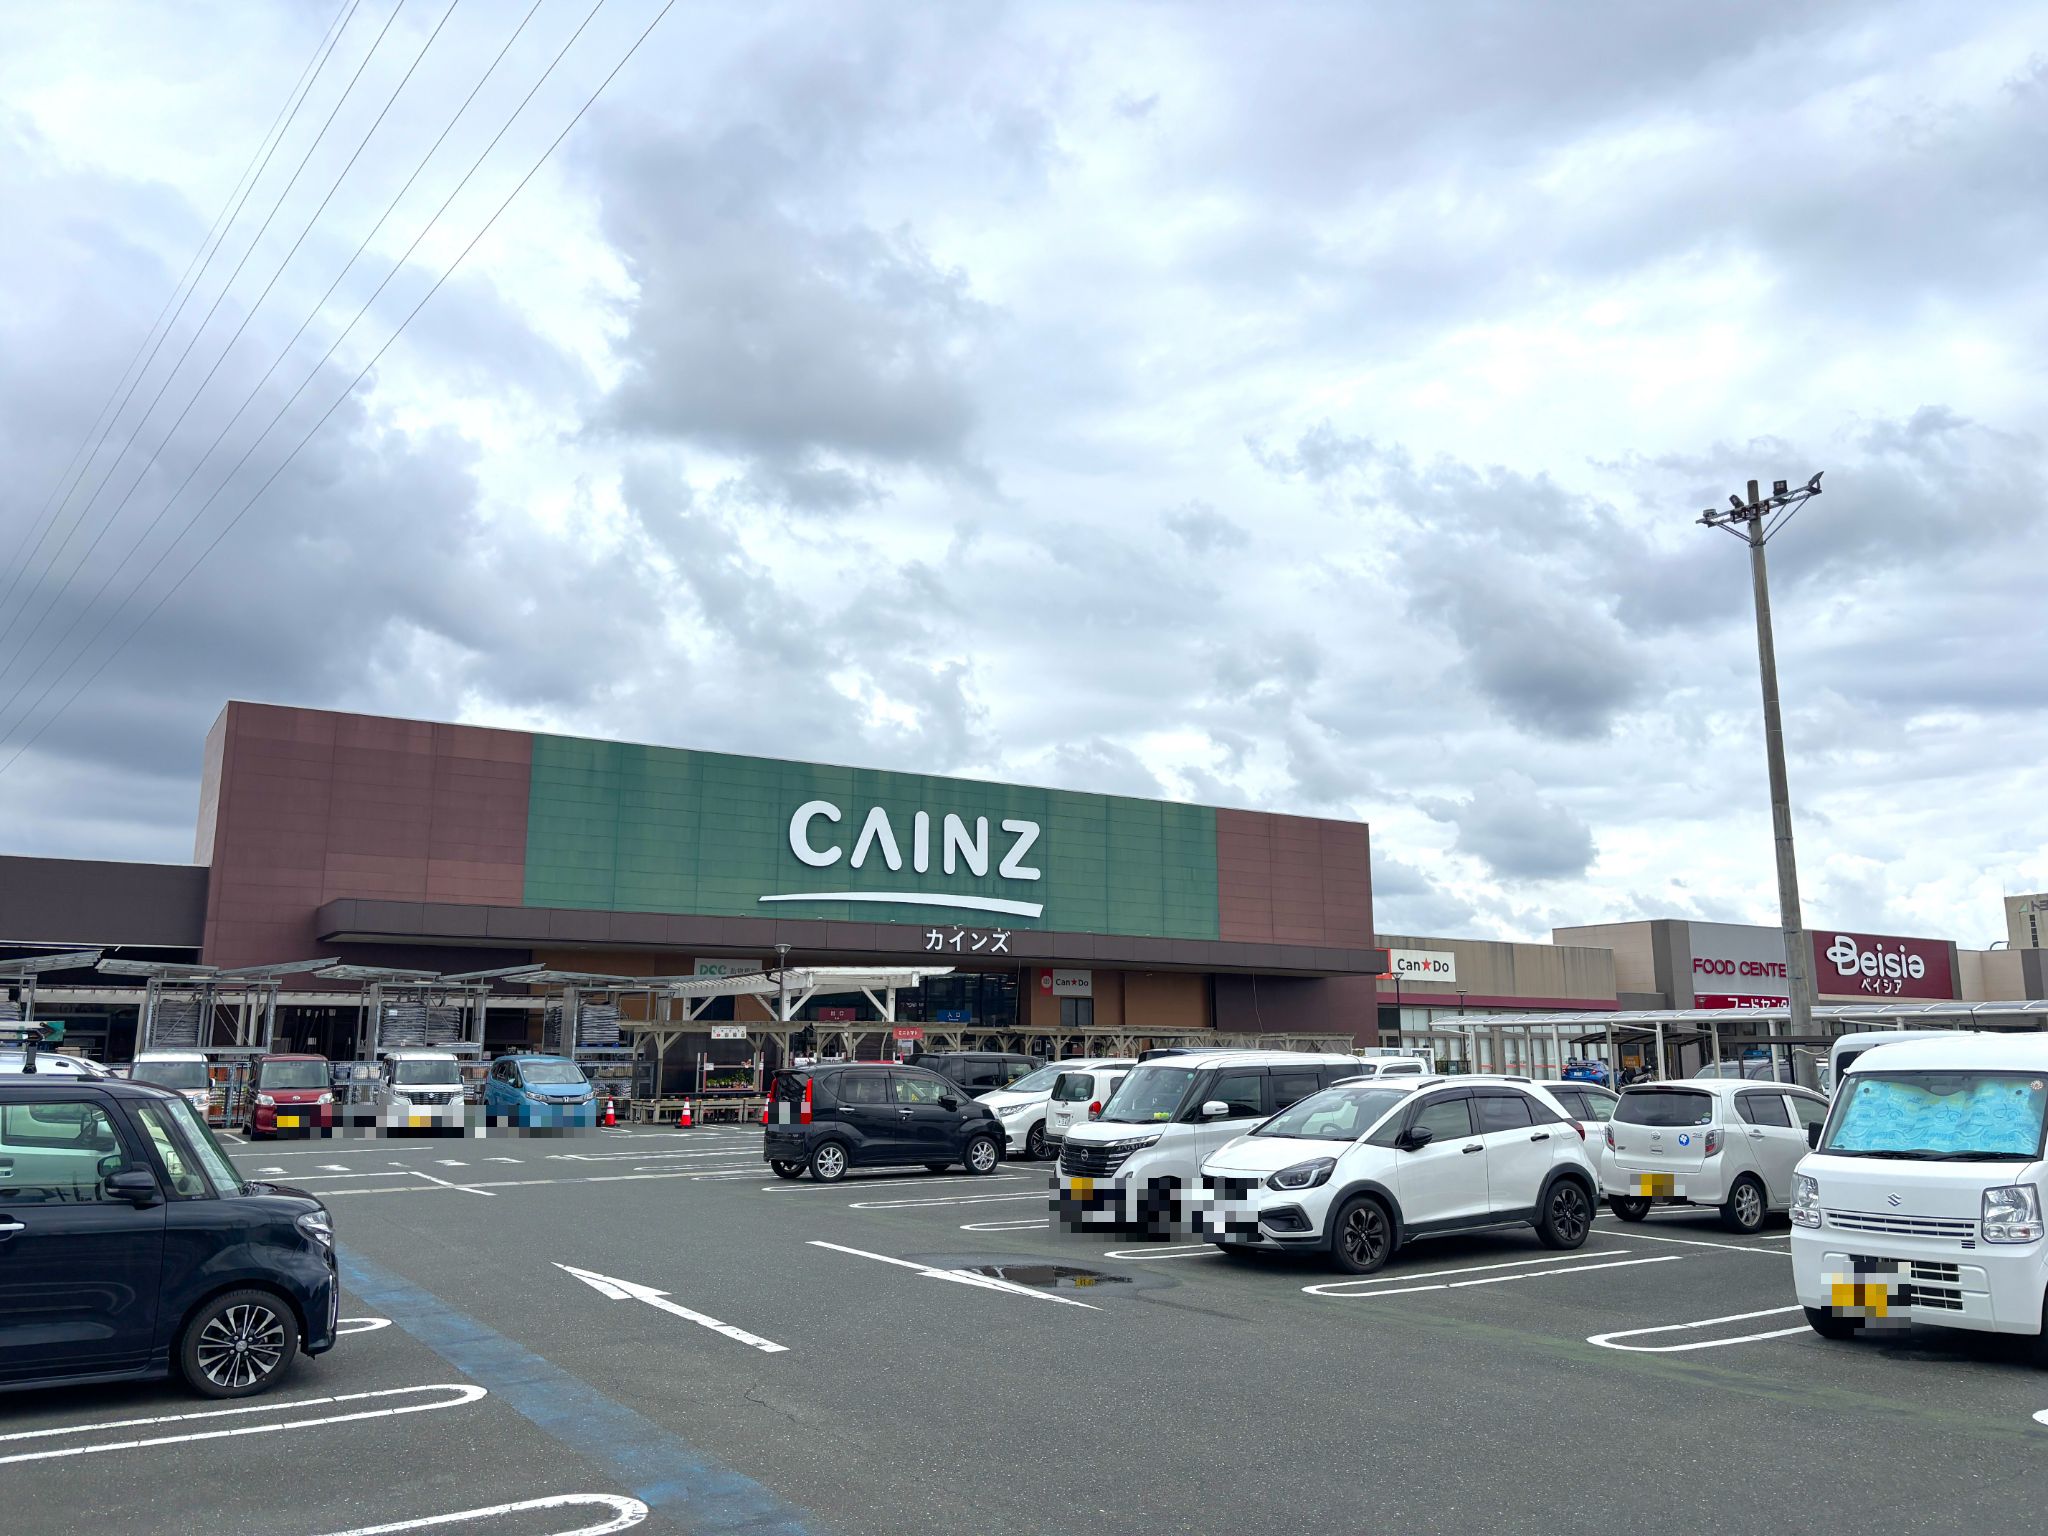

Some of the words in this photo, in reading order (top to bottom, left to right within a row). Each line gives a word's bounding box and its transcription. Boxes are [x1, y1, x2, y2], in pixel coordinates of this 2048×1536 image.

[789, 800, 1041, 880] CAINZ
[925, 928, 1011, 953] カインズ
[1397, 958, 1420, 972] Can
[1433, 960, 1450, 973] Do
[1826, 935, 1925, 979] Beisia
[1693, 958, 1736, 975] FOOD
[1739, 961, 1787, 978] CENTE
[1055, 978, 1070, 986] Can
[1861, 978, 1902, 994] ベイシア
